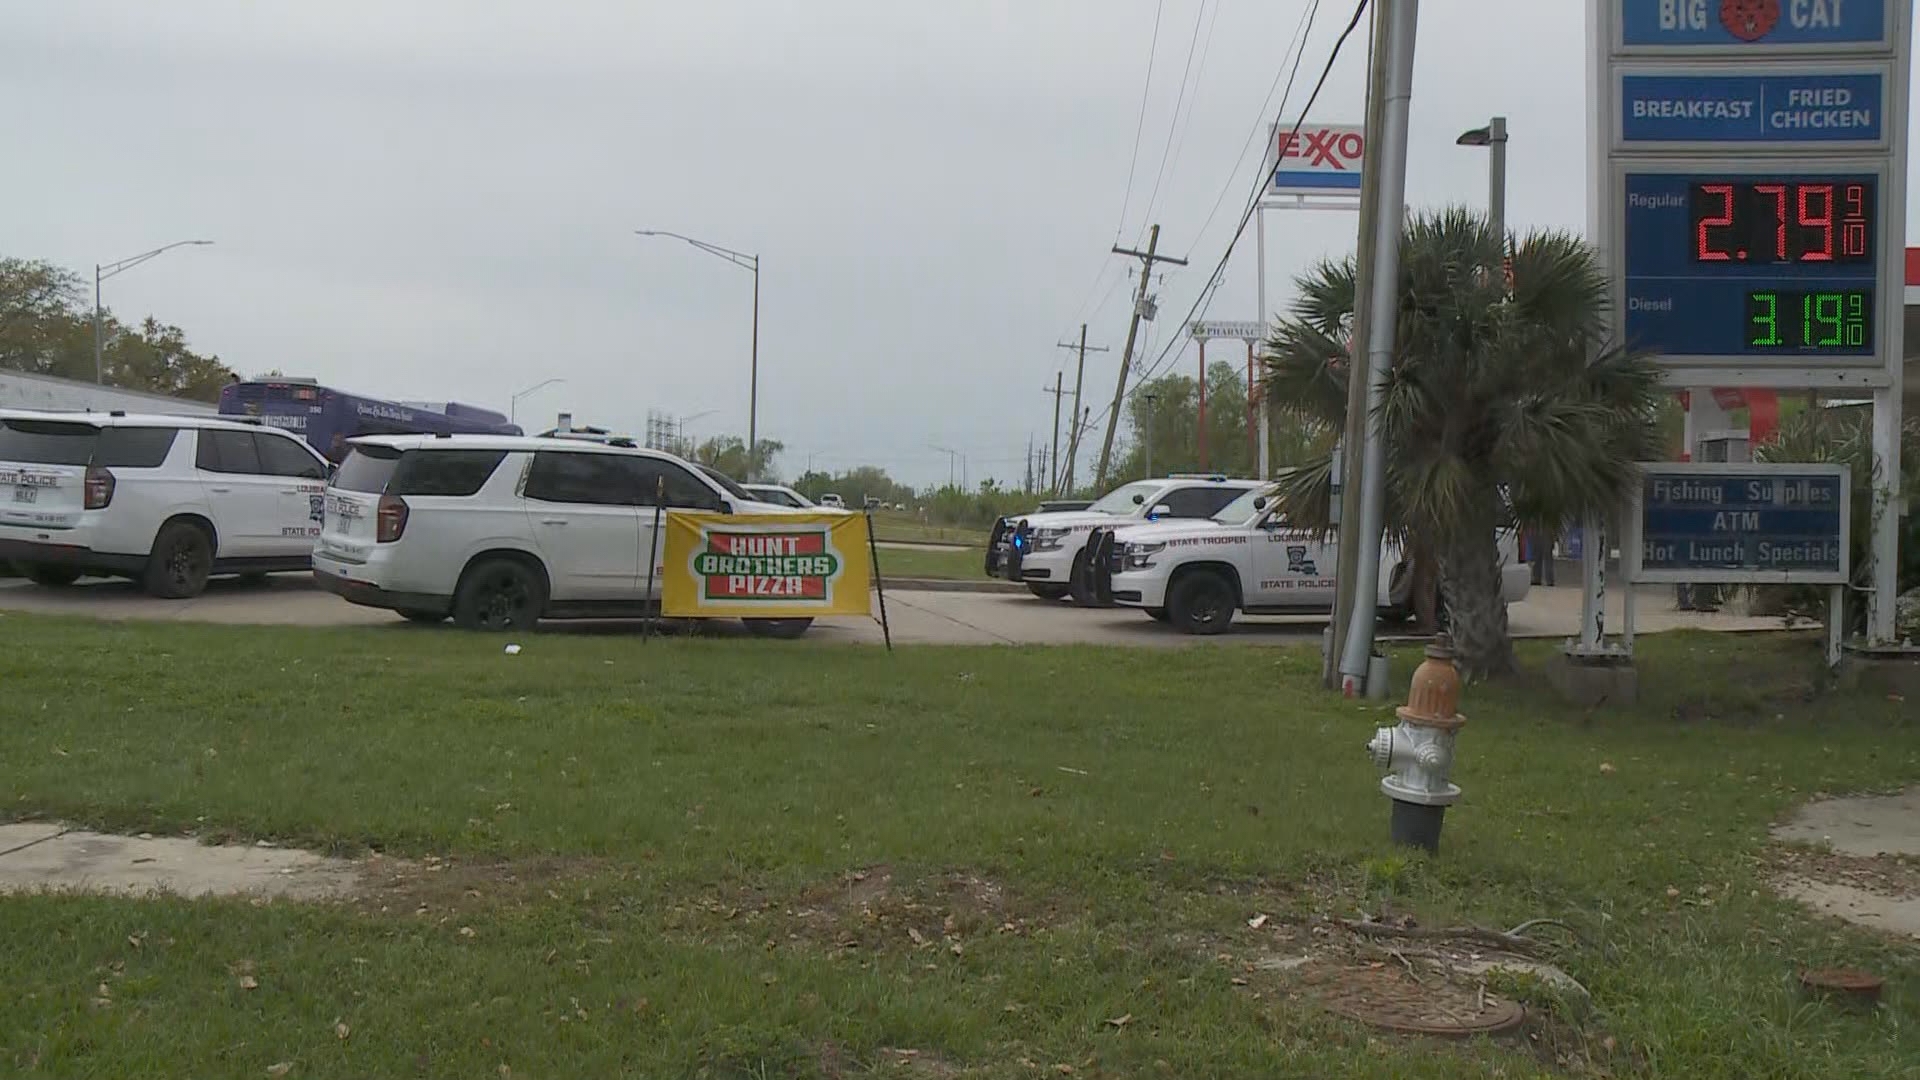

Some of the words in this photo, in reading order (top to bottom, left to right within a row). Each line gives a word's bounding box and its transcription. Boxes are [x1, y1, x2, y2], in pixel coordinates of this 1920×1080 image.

[1659, 0, 1706, 30] BIG
[1790, 0, 1840, 29] CAT
[1789, 89, 1851, 107] FRIED
[1633, 101, 1752, 118] BREAKFAST
[1771, 111, 1870, 128] CHICKEN
[1279, 129, 1363, 170] EXXO
[1629, 193, 1684, 209] Regular
[1697, 184, 1833, 262] 2.79
[1629, 298, 1672, 312] Diesel
[1752, 293, 1842, 346] 3.19
[1206, 327, 1256, 337] PHARMAC
[21, 474, 57, 485] POLICE
[1653, 480, 1723, 503] Fishing
[1713, 511, 1759, 531] ATM
[731, 536, 800, 556] HUNT
[1168, 536, 1198, 547] STATE
[1201, 535, 1247, 546] TROOPER
[1643, 542, 1676, 561] Hot
[1690, 542, 1744, 561] Lunch
[1759, 543, 1839, 565] Specials
[702, 556, 830, 576] BROTHERS
[728, 576, 802, 595] PIZZA
[1261, 580, 1294, 589] STATE
[1297, 579, 1335, 588] POLICE
